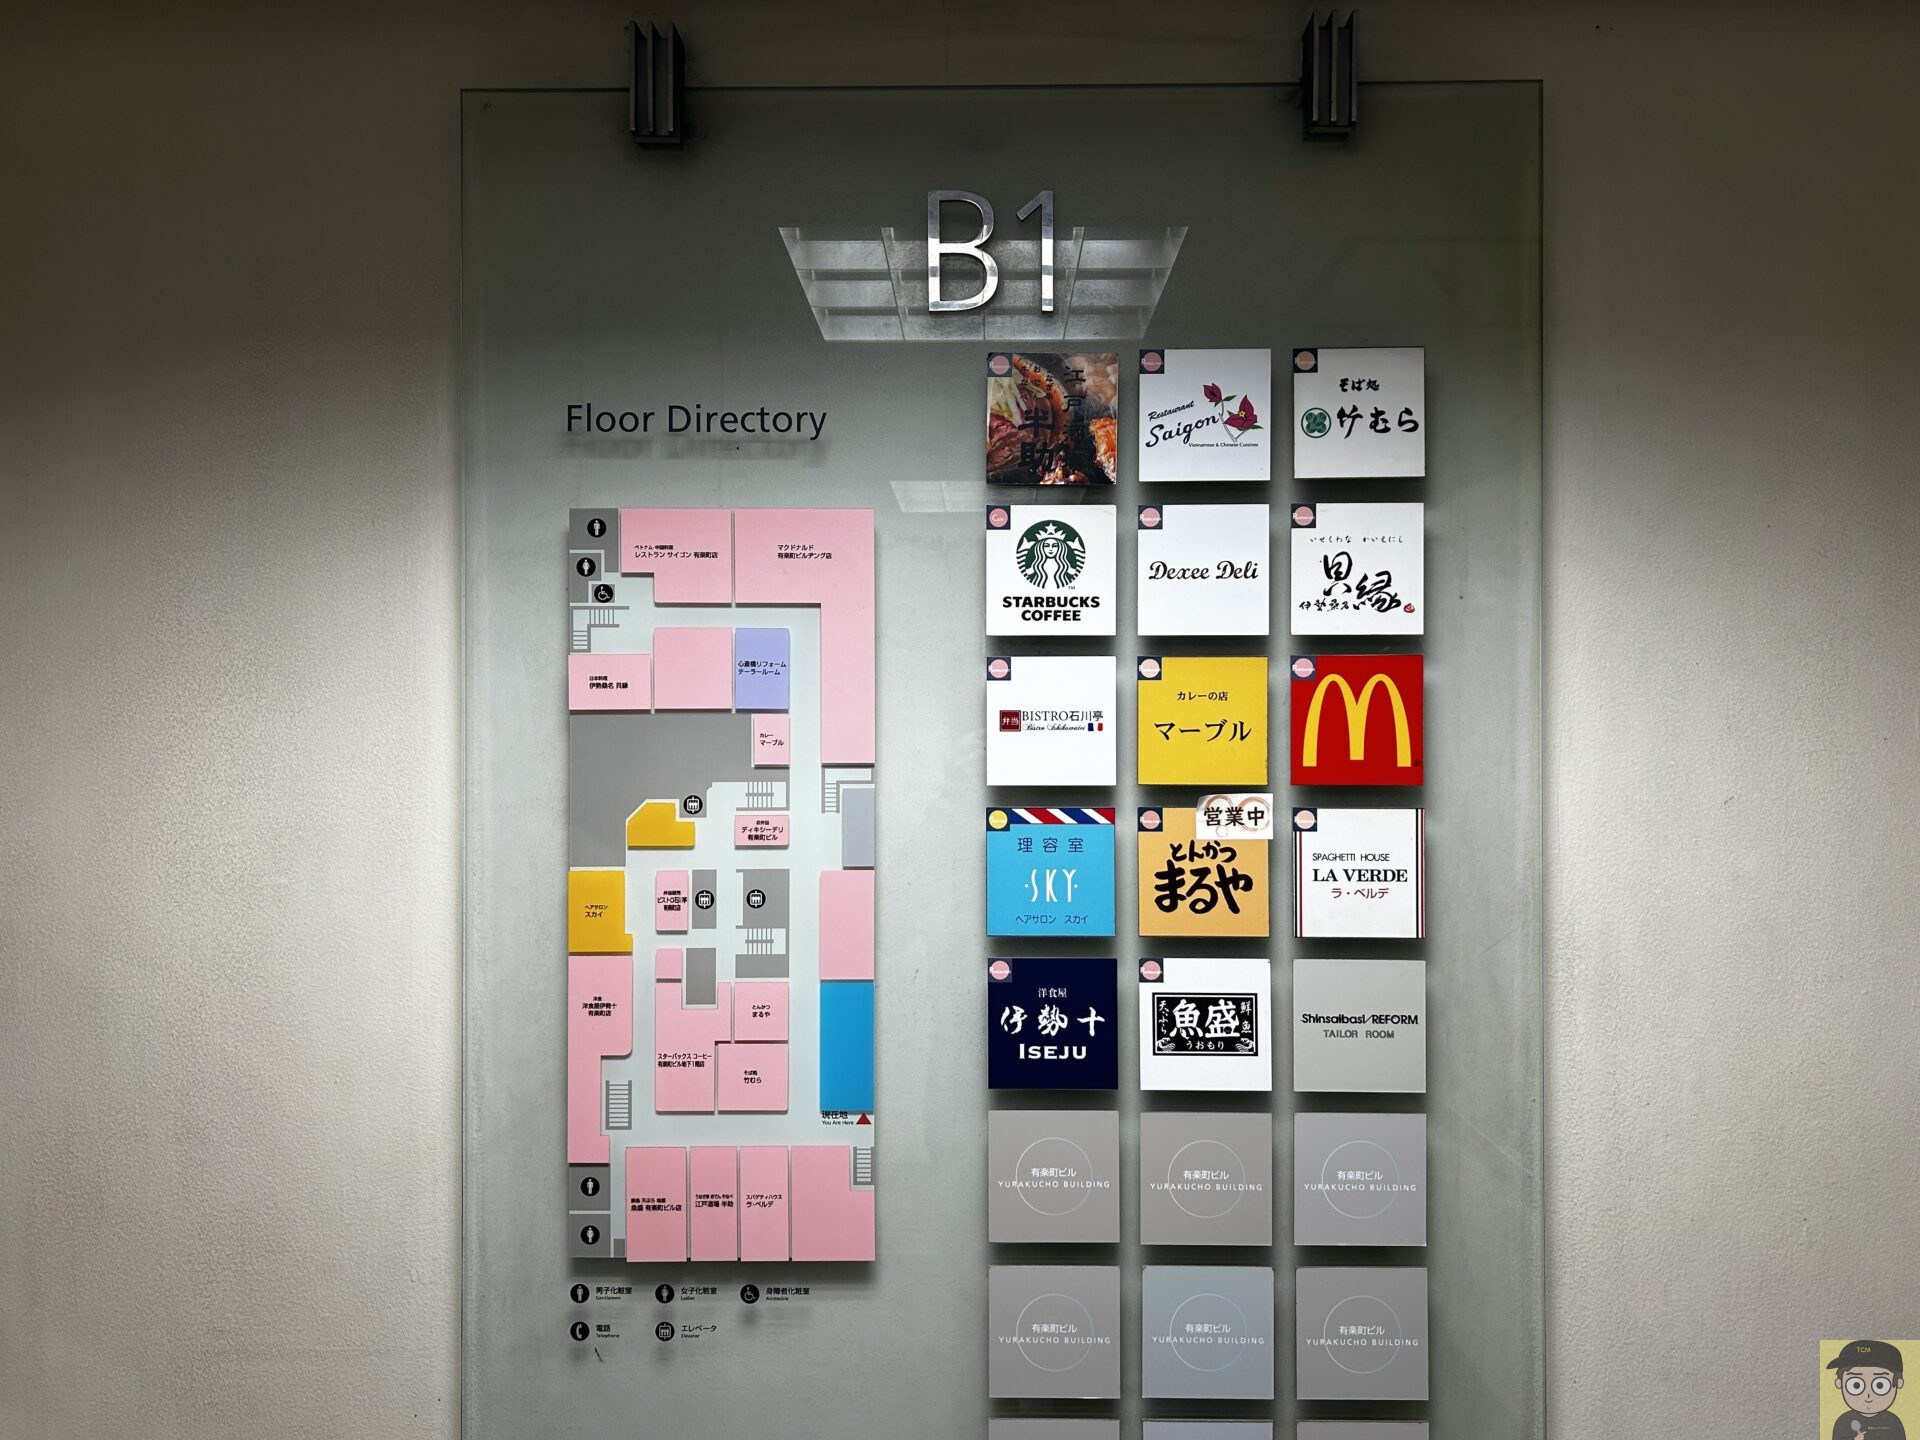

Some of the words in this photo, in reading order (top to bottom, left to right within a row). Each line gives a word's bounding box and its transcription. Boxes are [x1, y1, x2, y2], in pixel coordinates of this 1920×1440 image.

[927, 190, 1054, 312] B1
[1339, 378, 1379, 392] そば処
[1147, 400, 1195, 421] Restaurant
[568, 403, 655, 432] Floor
[669, 404, 826, 440] Directory
[1337, 405, 1419, 438] 竹むら
[1145, 414, 1219, 448] Saigon
[1149, 561, 1210, 580] Dexee
[1216, 561, 1258, 580] Deli
[1003, 596, 1100, 608] STARBUCKS
[1021, 610, 1081, 621] COFFEE
[1177, 691, 1228, 701] カレーの店
[1002, 717, 1019, 725] 弁当
[1155, 719, 1251, 741] マーブル
[1203, 806, 1264, 826] 営業中
[1017, 837, 1083, 852] 理容室
[1170, 839, 1237, 863] とんかつ
[1313, 853, 1355, 861] SPAGHETTI
[1313, 869, 1338, 881] LA
[1343, 869, 1407, 882] VERDE
[1154, 859, 1253, 914] まるや
[1332, 888, 1389, 898] ラ・ベルデ
[1016, 915, 1056, 924] ヘアサロン
[1065, 915, 1088, 924] スカイ
[1038, 988, 1067, 998] 洋食屋
[1001, 1004, 1105, 1036] 伊勢十
[1169, 998, 1240, 1039] 魚盛
[1323, 1030, 1358, 1038] TAILOR
[1366, 1030, 1394, 1038] ROOM
[1186, 1041, 1224, 1050] うおもり
[1020, 1044, 1086, 1059] ISEJU
[821, 1110, 848, 1120] 現在地
[1031, 1168, 1076, 1177] 有楽町ビル
[1183, 1170, 1229, 1180] 有楽町ビル
[1337, 1171, 1383, 1180] 有楽町ビル
[680, 1287, 718, 1295] 女子化粧室
[1032, 1324, 1077, 1333] 有楽町ビル
[1185, 1324, 1231, 1333] 有楽町ビル
[1339, 1326, 1385, 1335] 有楽町ビル
[999, 1335, 1059, 1343] YURAKUCHO
